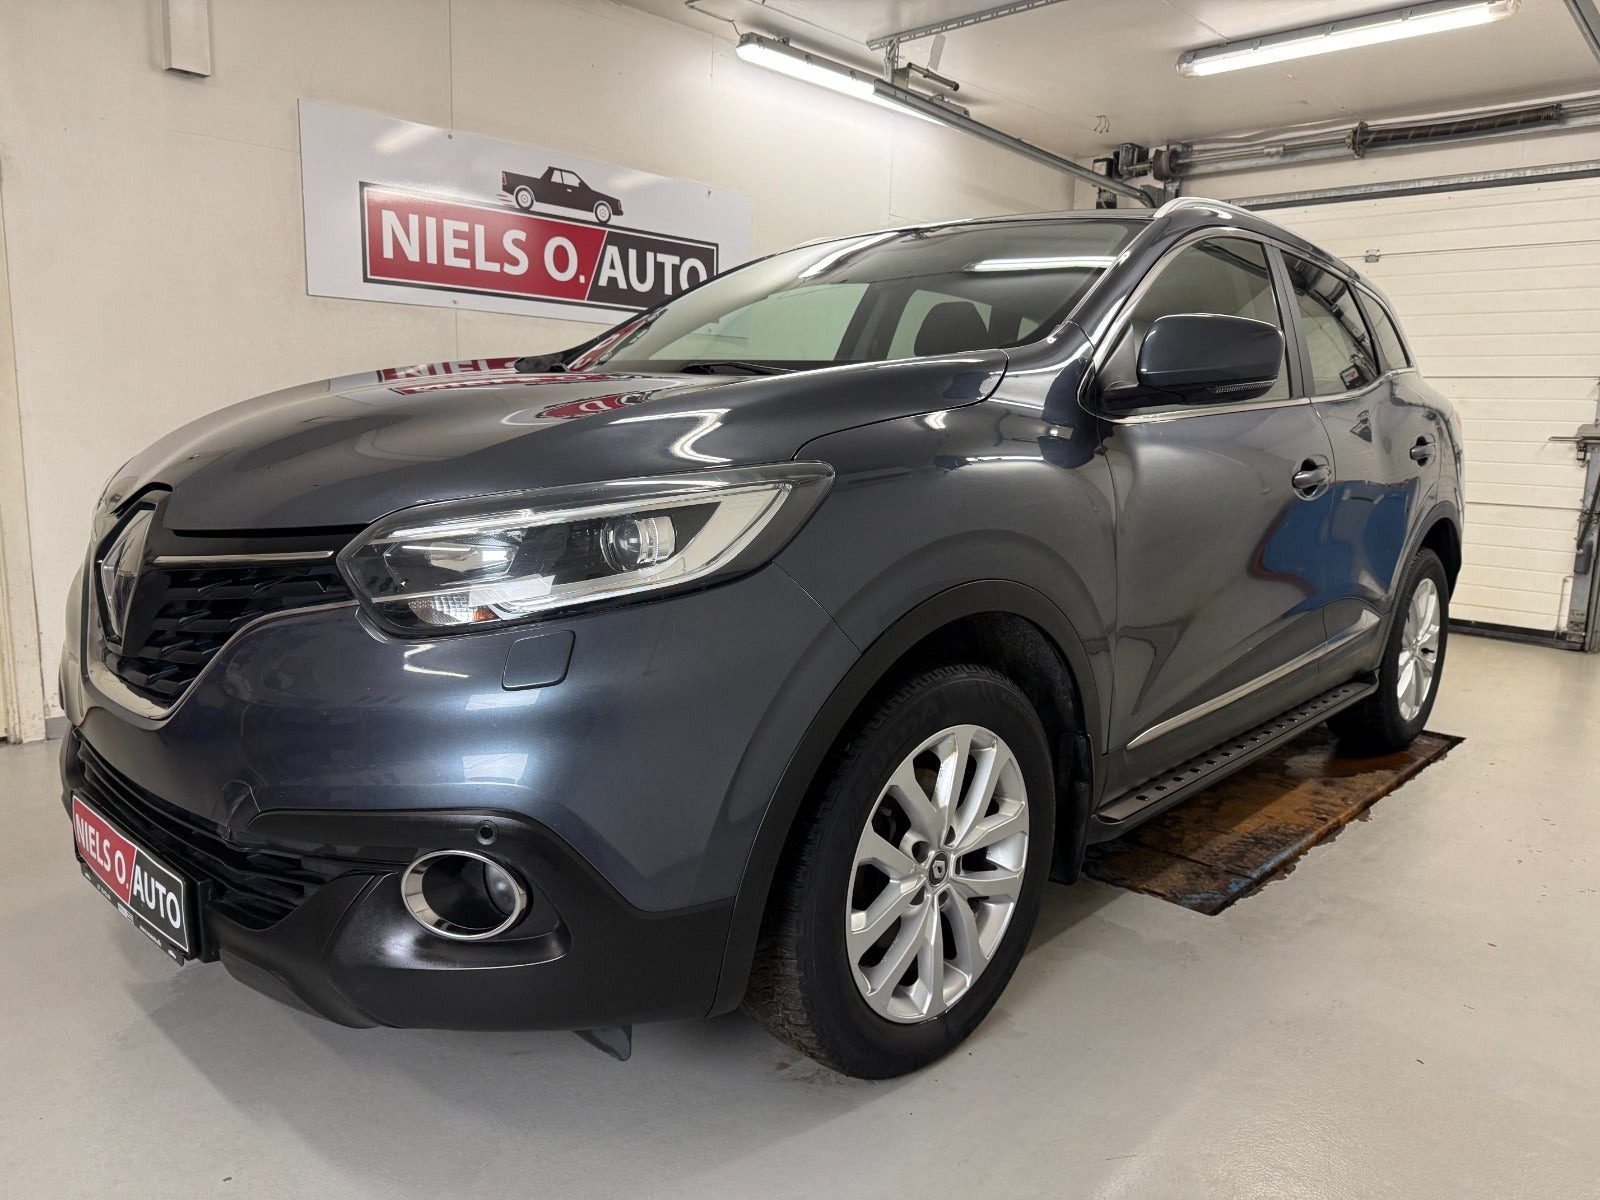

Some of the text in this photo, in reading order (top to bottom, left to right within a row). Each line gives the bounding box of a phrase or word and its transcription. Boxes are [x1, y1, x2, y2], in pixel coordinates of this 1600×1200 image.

[382, 211, 707, 294] NIELS O. AUTO
[75, 813, 181, 929] NIELS O. AUTO
